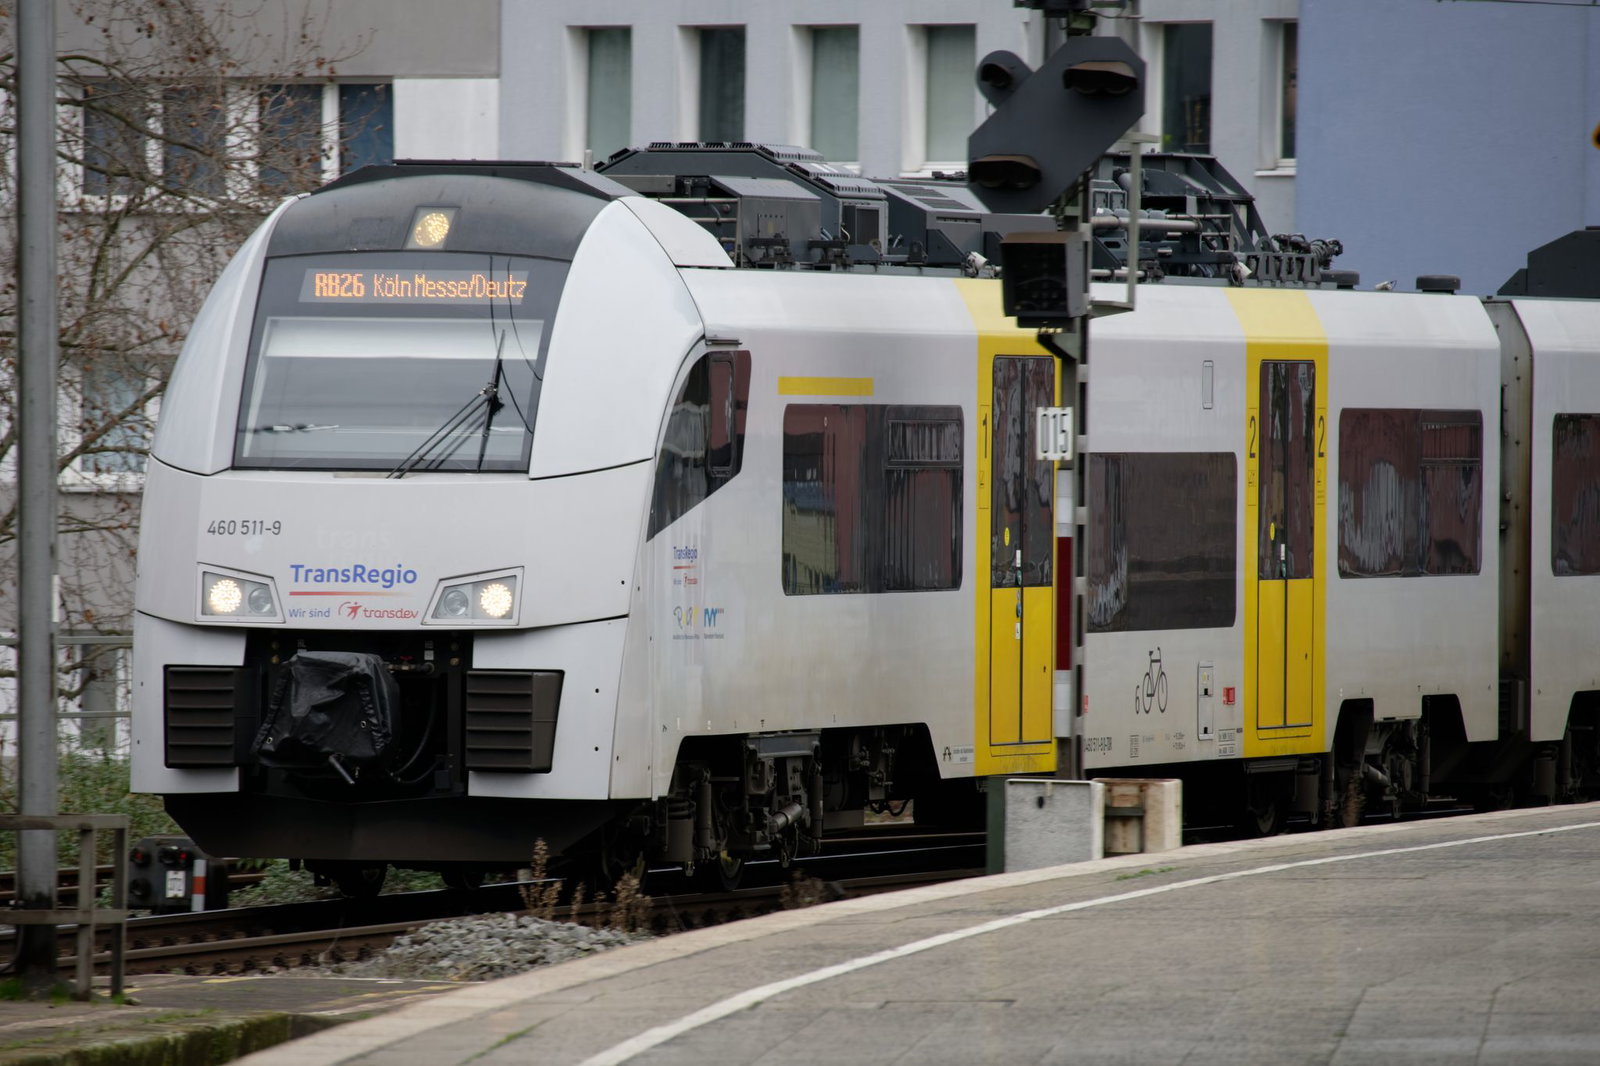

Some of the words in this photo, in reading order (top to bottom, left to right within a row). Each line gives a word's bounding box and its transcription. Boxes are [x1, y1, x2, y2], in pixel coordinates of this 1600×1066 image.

[314, 273, 366, 297] RB26
[373, 273, 412, 298] Köln
[414, 274, 528, 299] Messe/Deutz
[982, 412, 988, 459] 1
[1040, 413, 1069, 454] 015
[1249, 415, 1256, 459] 2
[1318, 415, 1325, 458] 2
[207, 519, 237, 536] 460
[240, 519, 282, 536] 511-9
[289, 563, 418, 589] TransRegio
[288, 608, 306, 619] Wir
[308, 607, 331, 619] sind
[363, 606, 420, 620] transdev
[1135, 684, 1140, 715] 6
